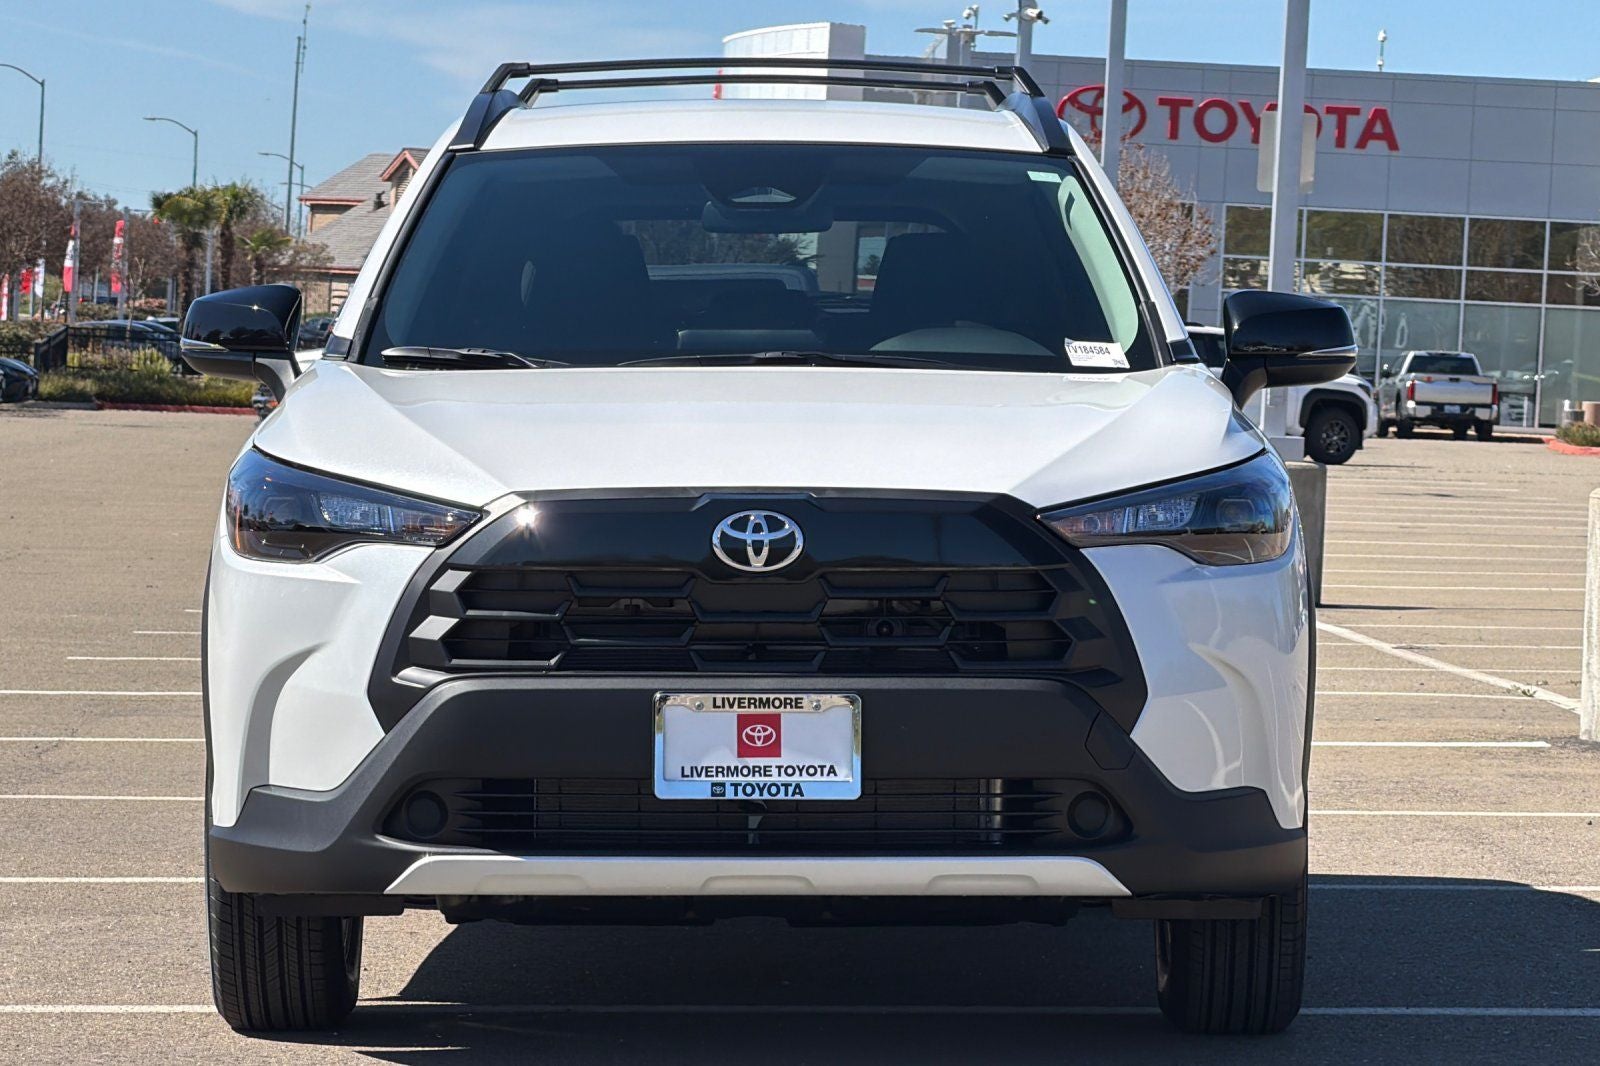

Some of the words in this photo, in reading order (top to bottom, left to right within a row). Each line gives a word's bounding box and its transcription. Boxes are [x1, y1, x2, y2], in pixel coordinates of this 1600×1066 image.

[1156, 97, 1400, 151] TOYTA
[712, 697, 804, 709] LIVERMORE
[680, 765, 773, 778] LIVERMORE
[775, 764, 838, 777] TOYOTA
[730, 782, 805, 797] TOYOTA
